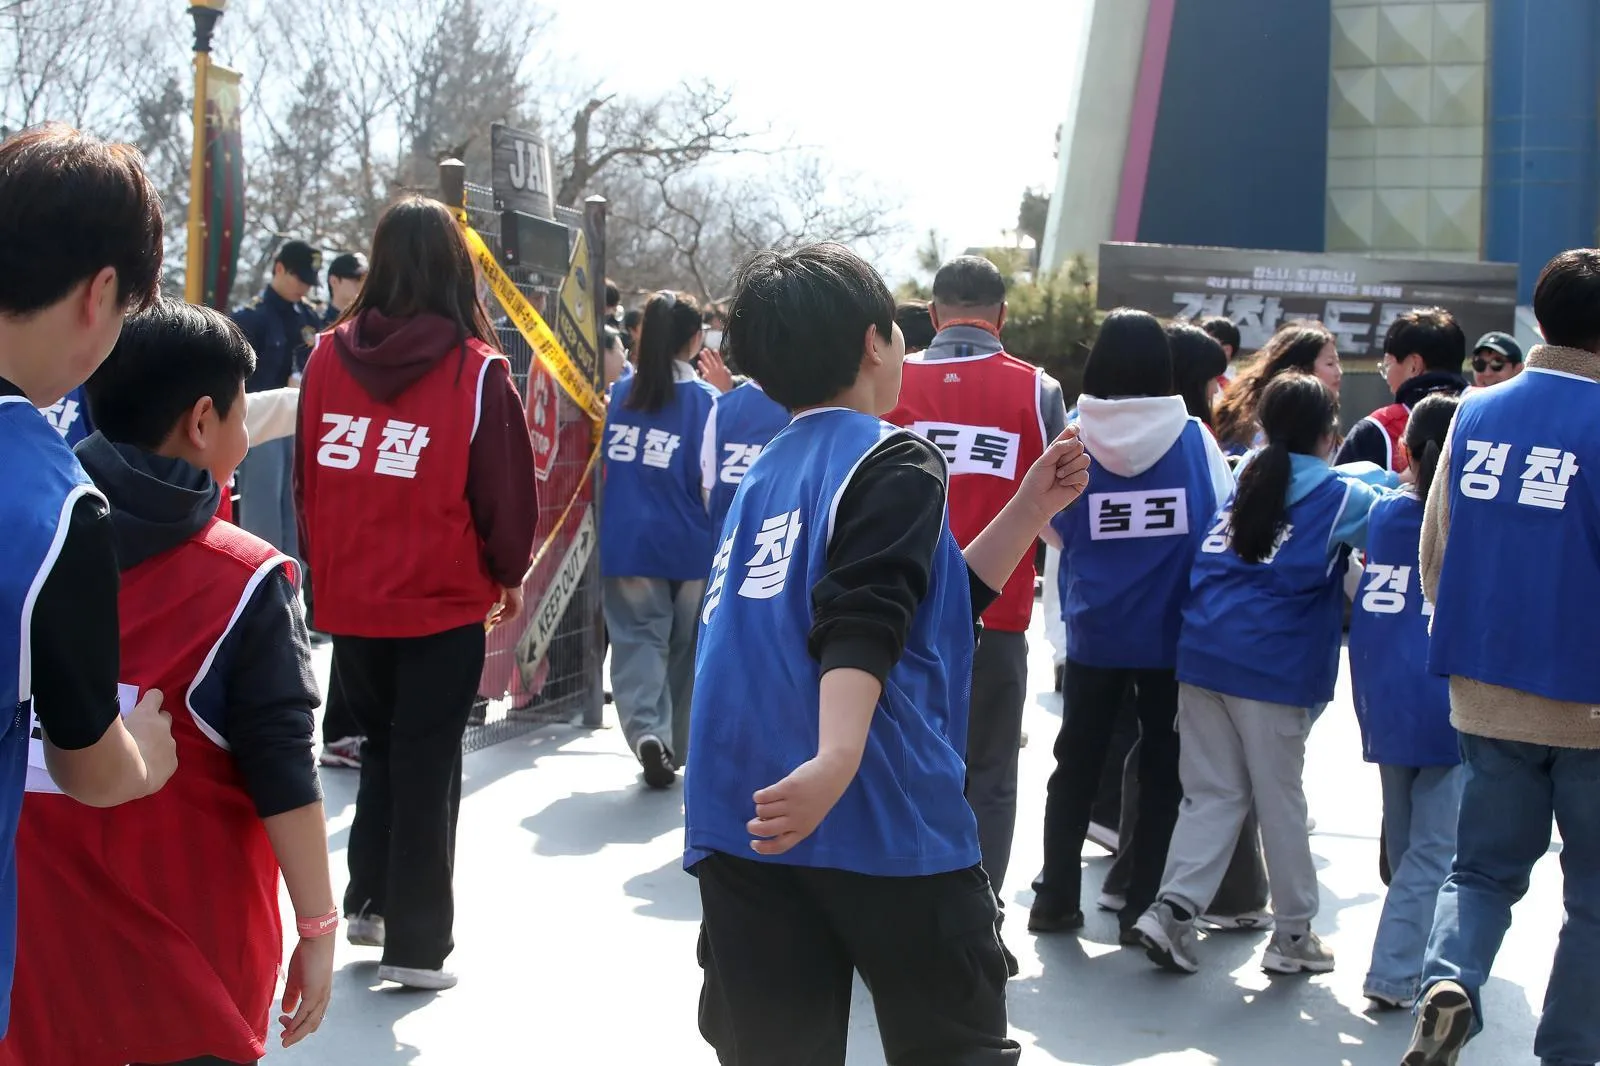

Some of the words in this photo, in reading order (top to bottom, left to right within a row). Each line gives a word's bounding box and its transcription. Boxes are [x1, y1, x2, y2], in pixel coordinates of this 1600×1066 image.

[317, 413, 430, 478] 경찰
[607, 424, 681, 469] 경찰
[720, 443, 764, 484] 경
[1460, 439, 1580, 511] 경찰
[538, 584, 562, 642] KEEP
[561, 547, 580, 594] OUT
